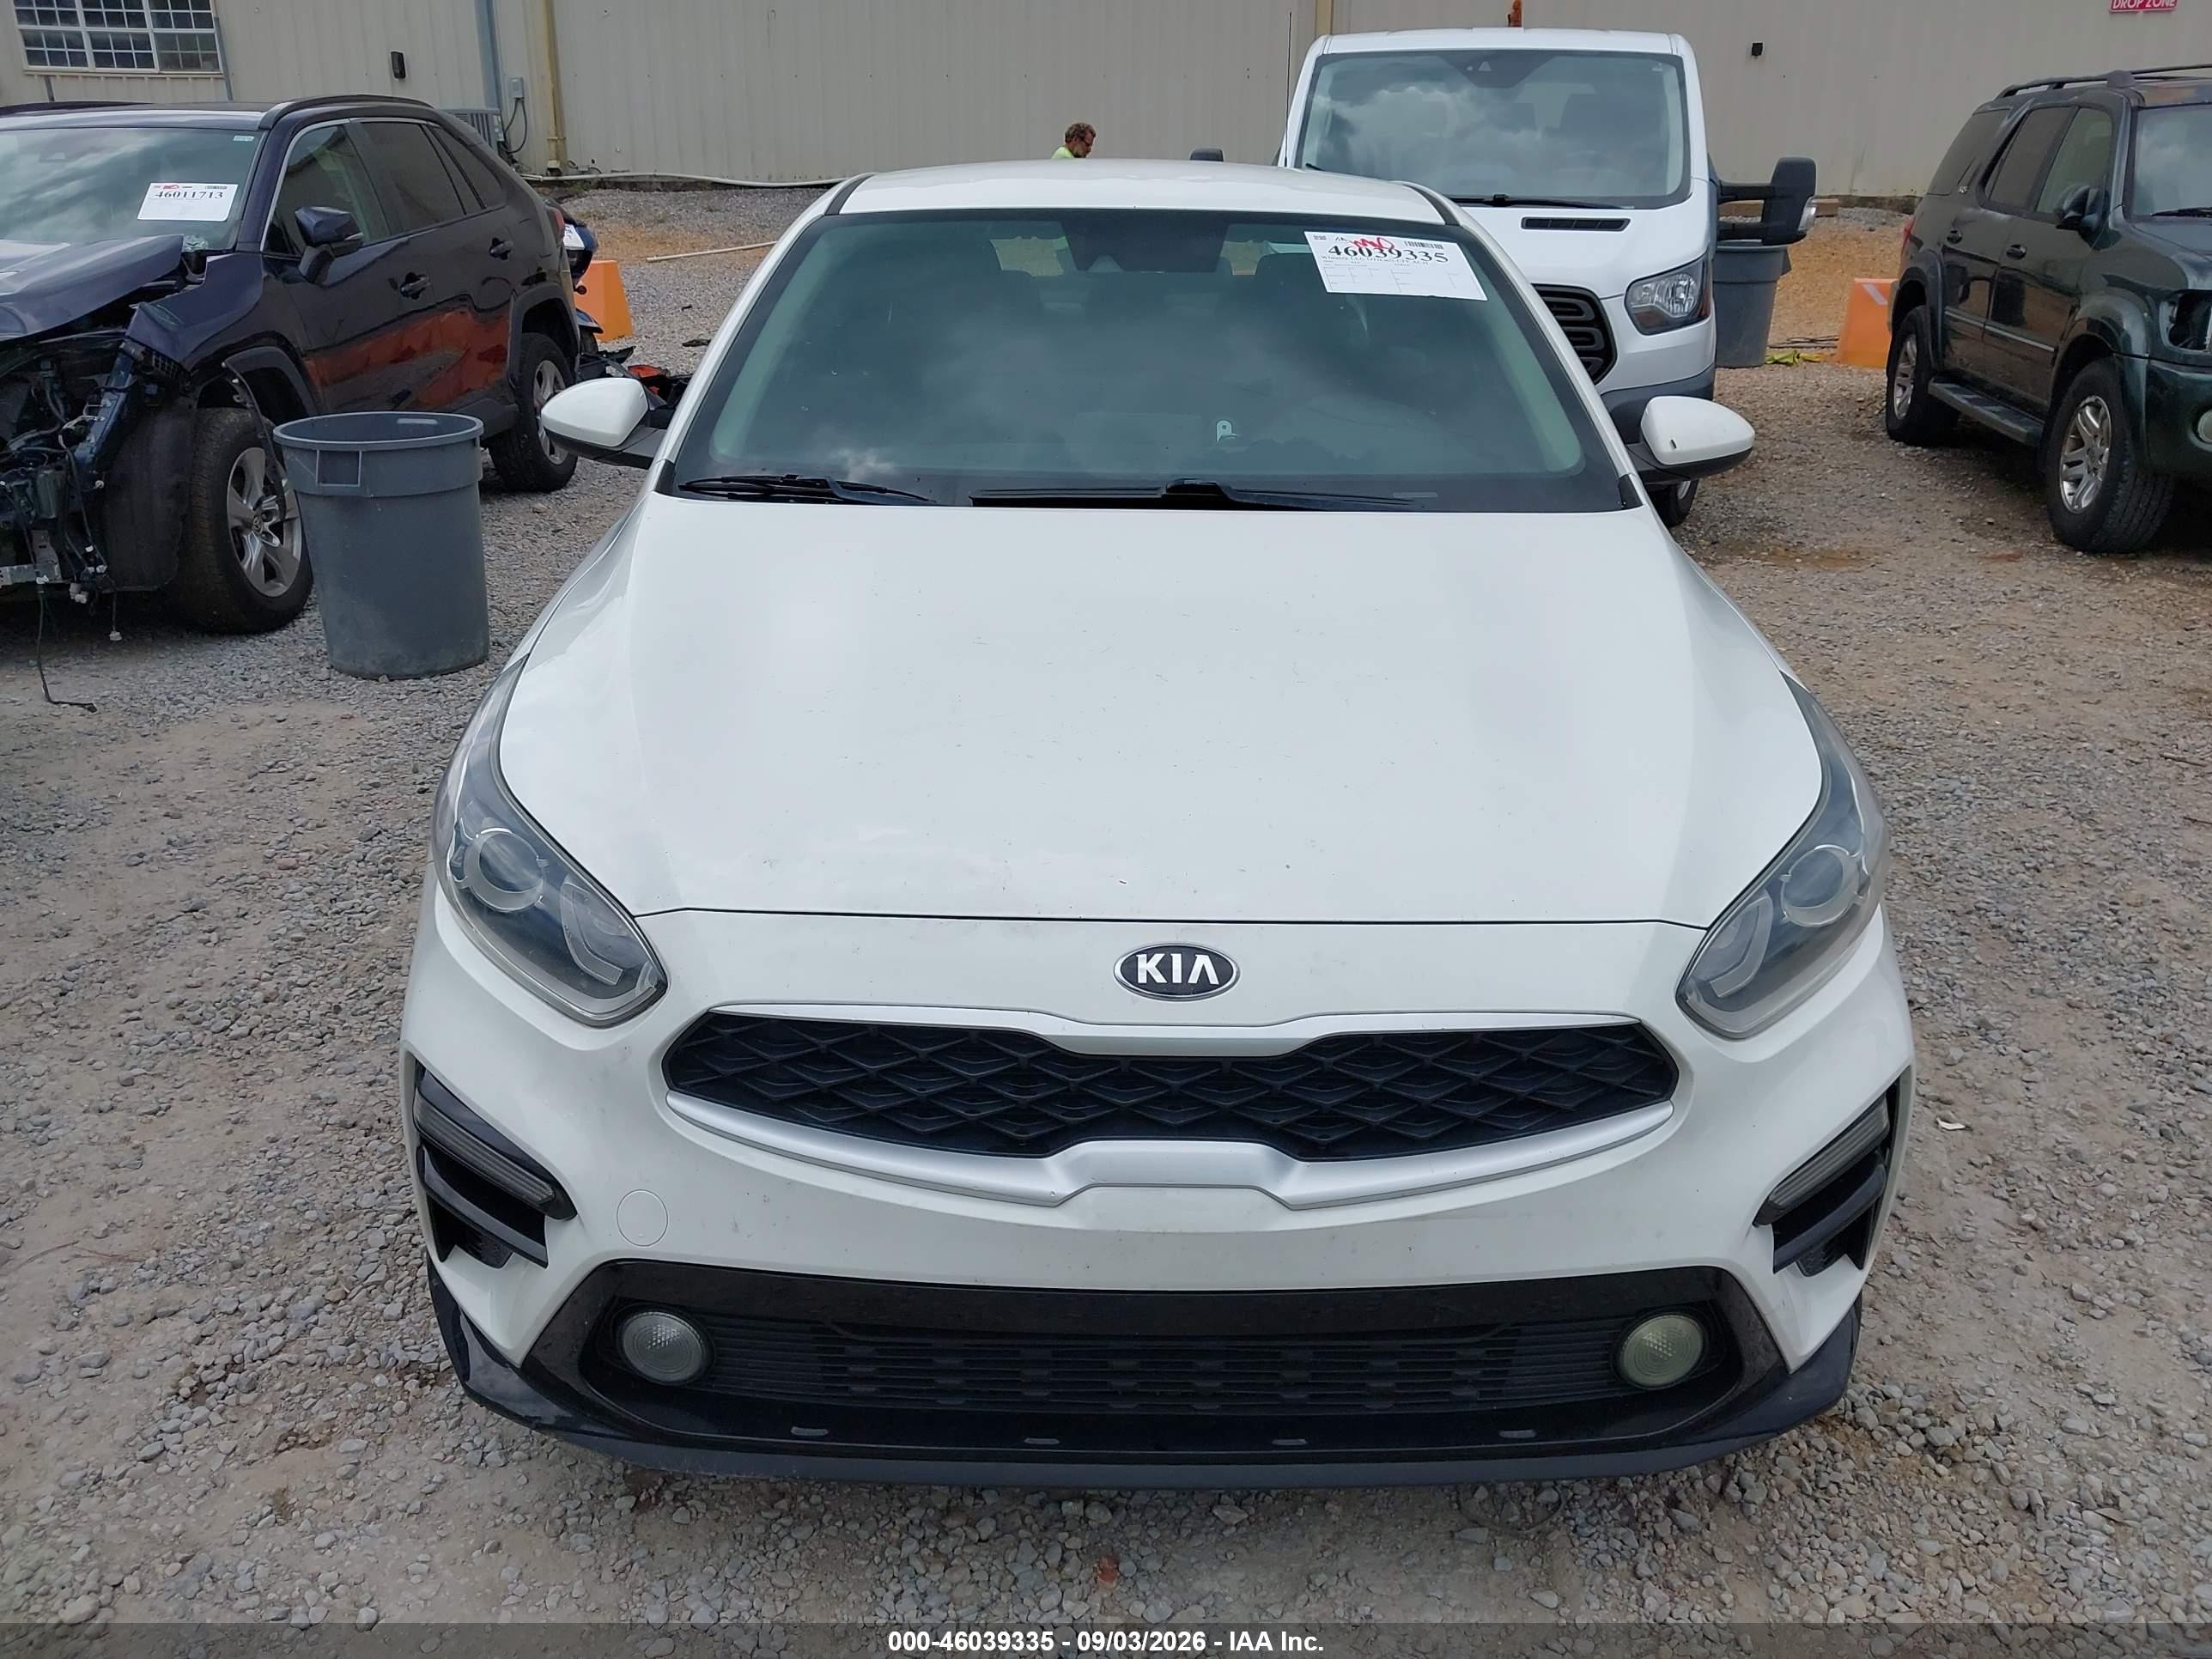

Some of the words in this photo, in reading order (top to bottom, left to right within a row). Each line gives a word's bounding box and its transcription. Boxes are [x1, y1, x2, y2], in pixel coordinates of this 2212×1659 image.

[2112, 0, 2143, 9] DROP
[155, 191, 223, 199] 46011713
[1328, 245, 1449, 263] 46039335
[1136, 953, 1219, 985] KIA
